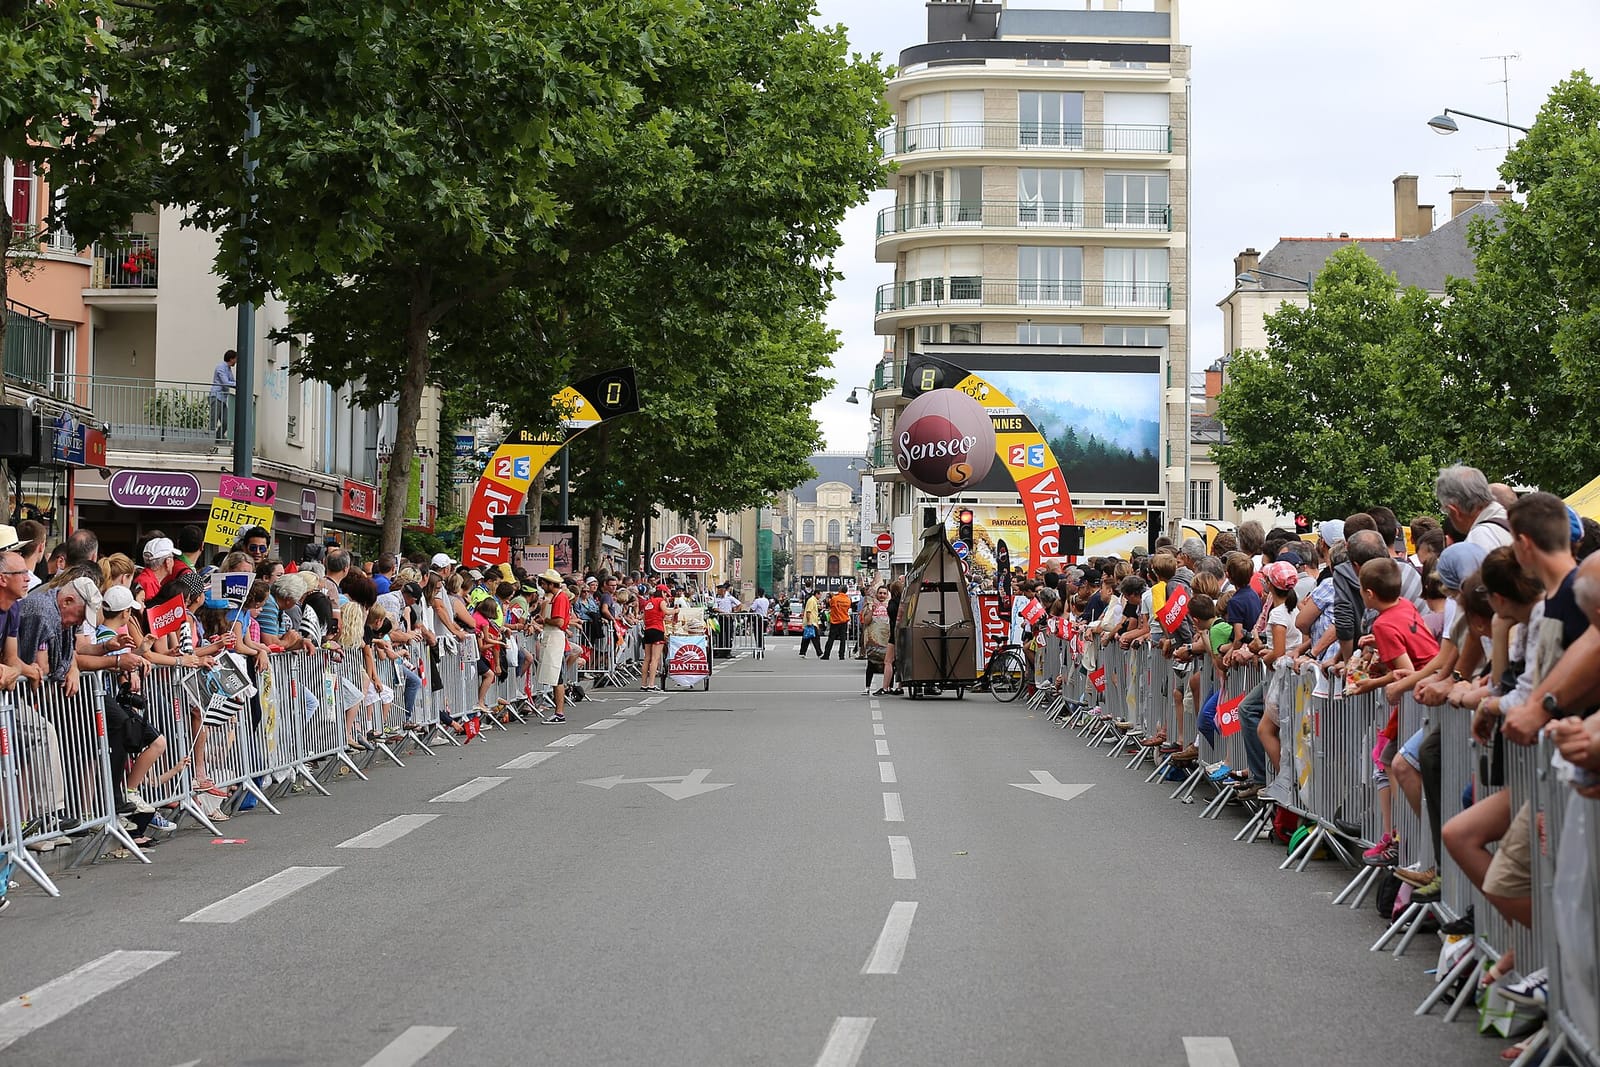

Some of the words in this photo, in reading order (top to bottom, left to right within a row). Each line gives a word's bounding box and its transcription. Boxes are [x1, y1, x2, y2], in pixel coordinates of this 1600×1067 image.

[993, 418, 1022, 430] NNES
[897, 431, 977, 471] Senseo
[118, 475, 191, 504] Margaux
[167, 498, 185, 506] Déco
[230, 501, 249, 511] ICI
[211, 507, 267, 526] GALETTE
[1030, 471, 1069, 569] Vittel
[991, 519, 1029, 527] PARTAGEO
[659, 557, 707, 566] BANETTE
[801, 577, 854, 585] LMIÈRES
[670, 663, 709, 672] BANETT
